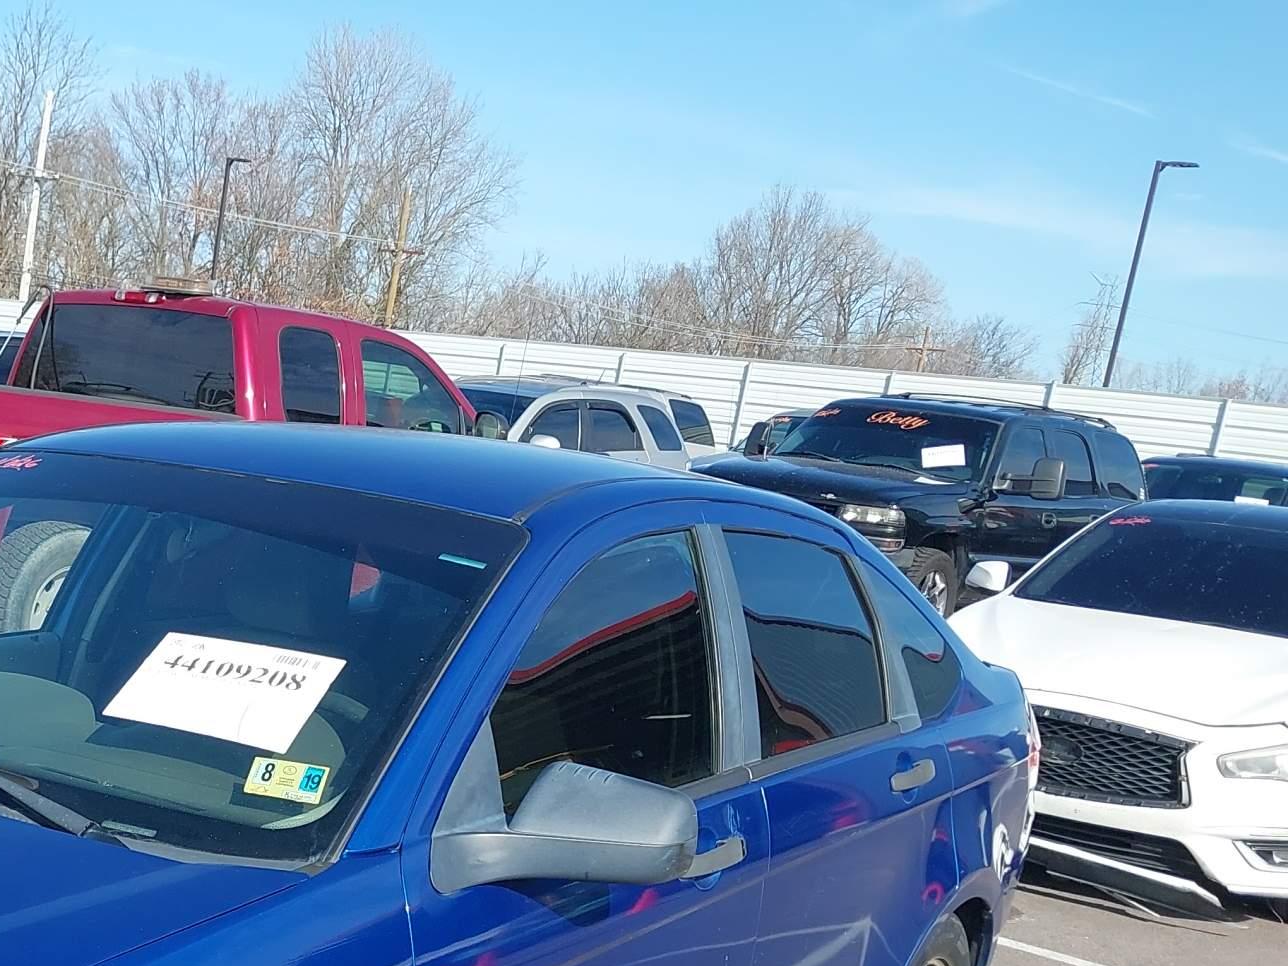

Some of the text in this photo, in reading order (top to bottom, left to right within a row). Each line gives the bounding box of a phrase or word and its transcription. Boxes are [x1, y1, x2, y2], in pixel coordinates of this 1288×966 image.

[866, 411, 931, 430] Betty
[164, 655, 307, 691] 44109208
[261, 762, 276, 782] 8
[302, 773, 322, 791] 19
